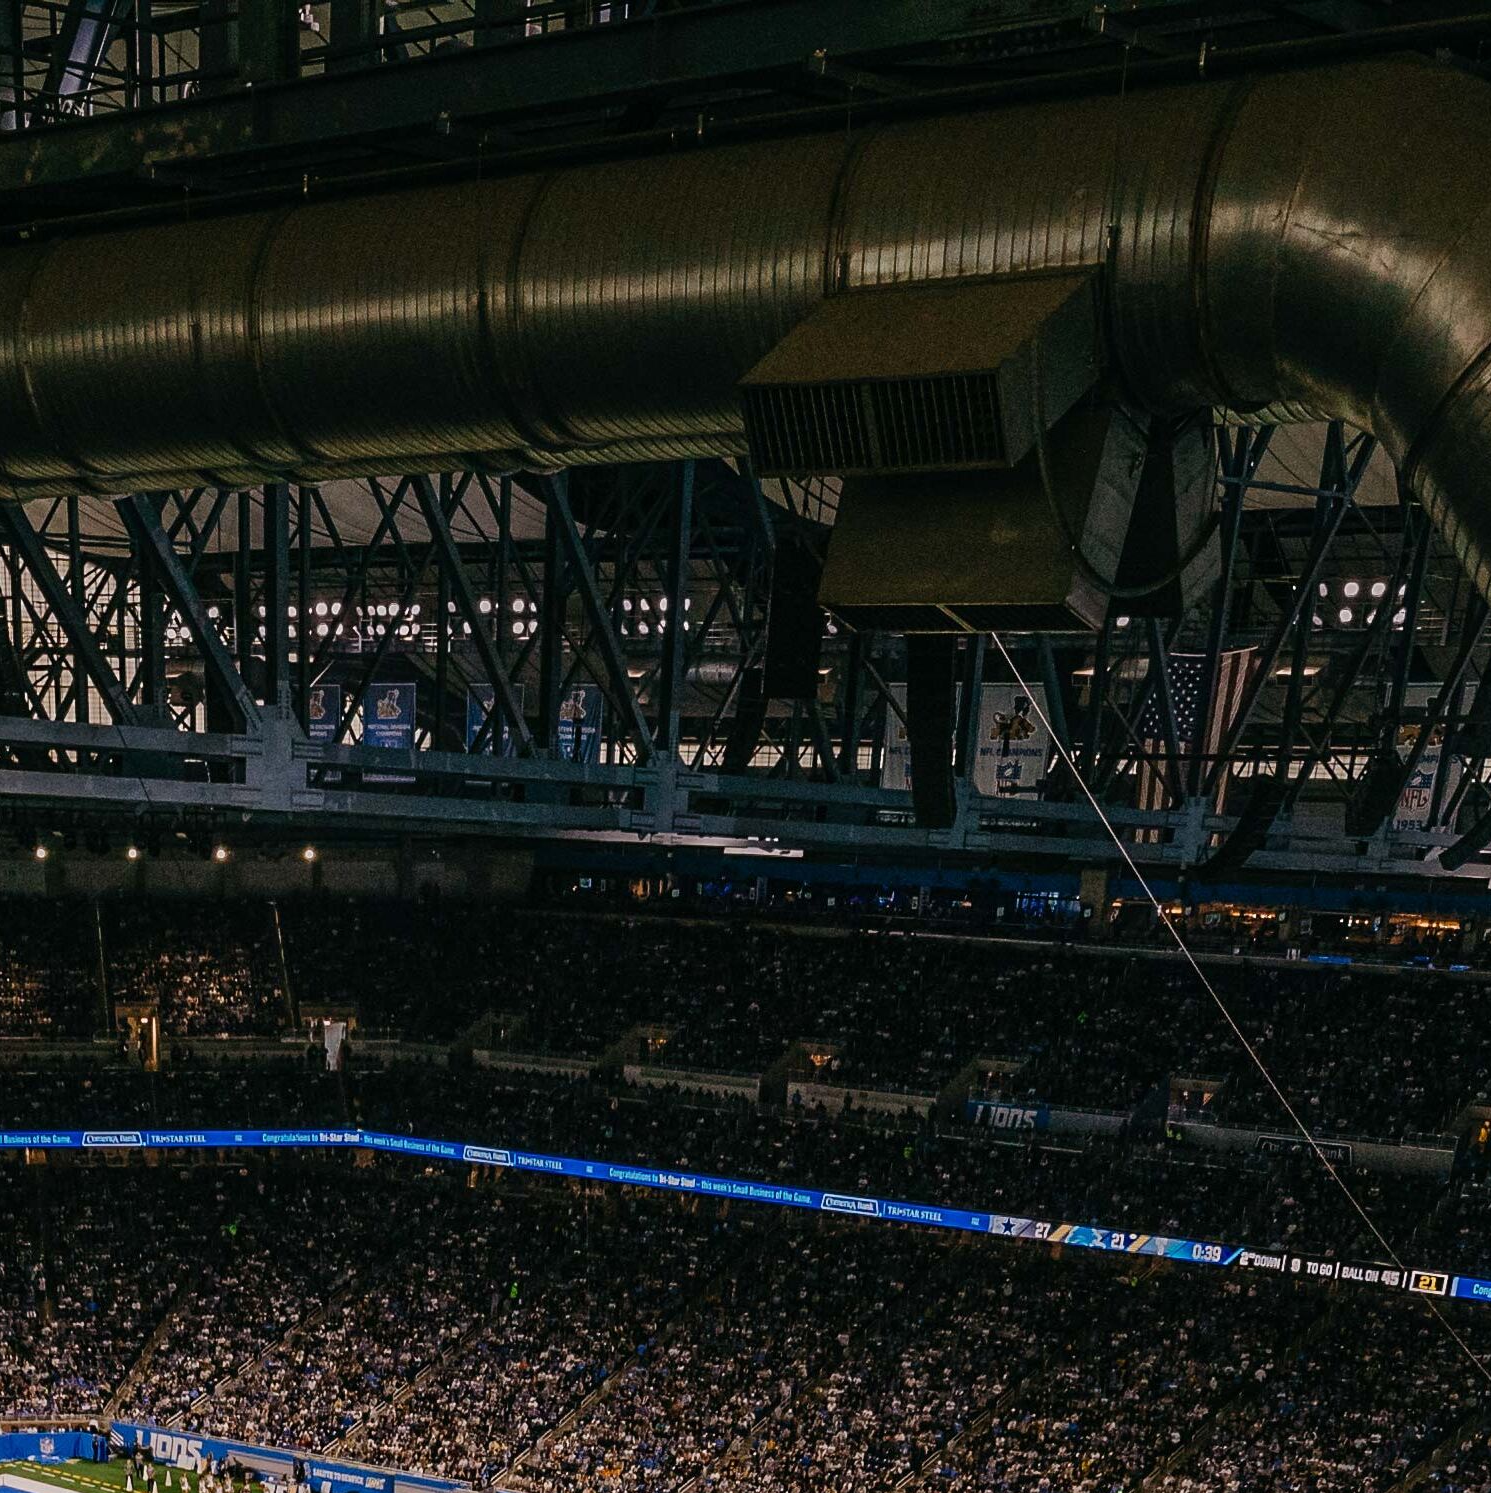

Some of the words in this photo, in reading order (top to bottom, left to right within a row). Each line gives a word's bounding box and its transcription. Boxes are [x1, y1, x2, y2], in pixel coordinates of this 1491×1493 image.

[974, 1103, 1037, 1130] LIONS
[1035, 1222, 1050, 1239] 27
[1111, 1233, 1125, 1249] 21
[1192, 1244, 1222, 1263] 0:39
[1254, 1255, 1281, 1270] DOWN
[1307, 1261, 1319, 1274] TO
[1320, 1263, 1333, 1276] GO
[1342, 1266, 1365, 1281] BALL
[1365, 1270, 1380, 1284] ON
[1418, 1275, 1437, 1291] 21
[136, 1429, 203, 1470] LIONS
